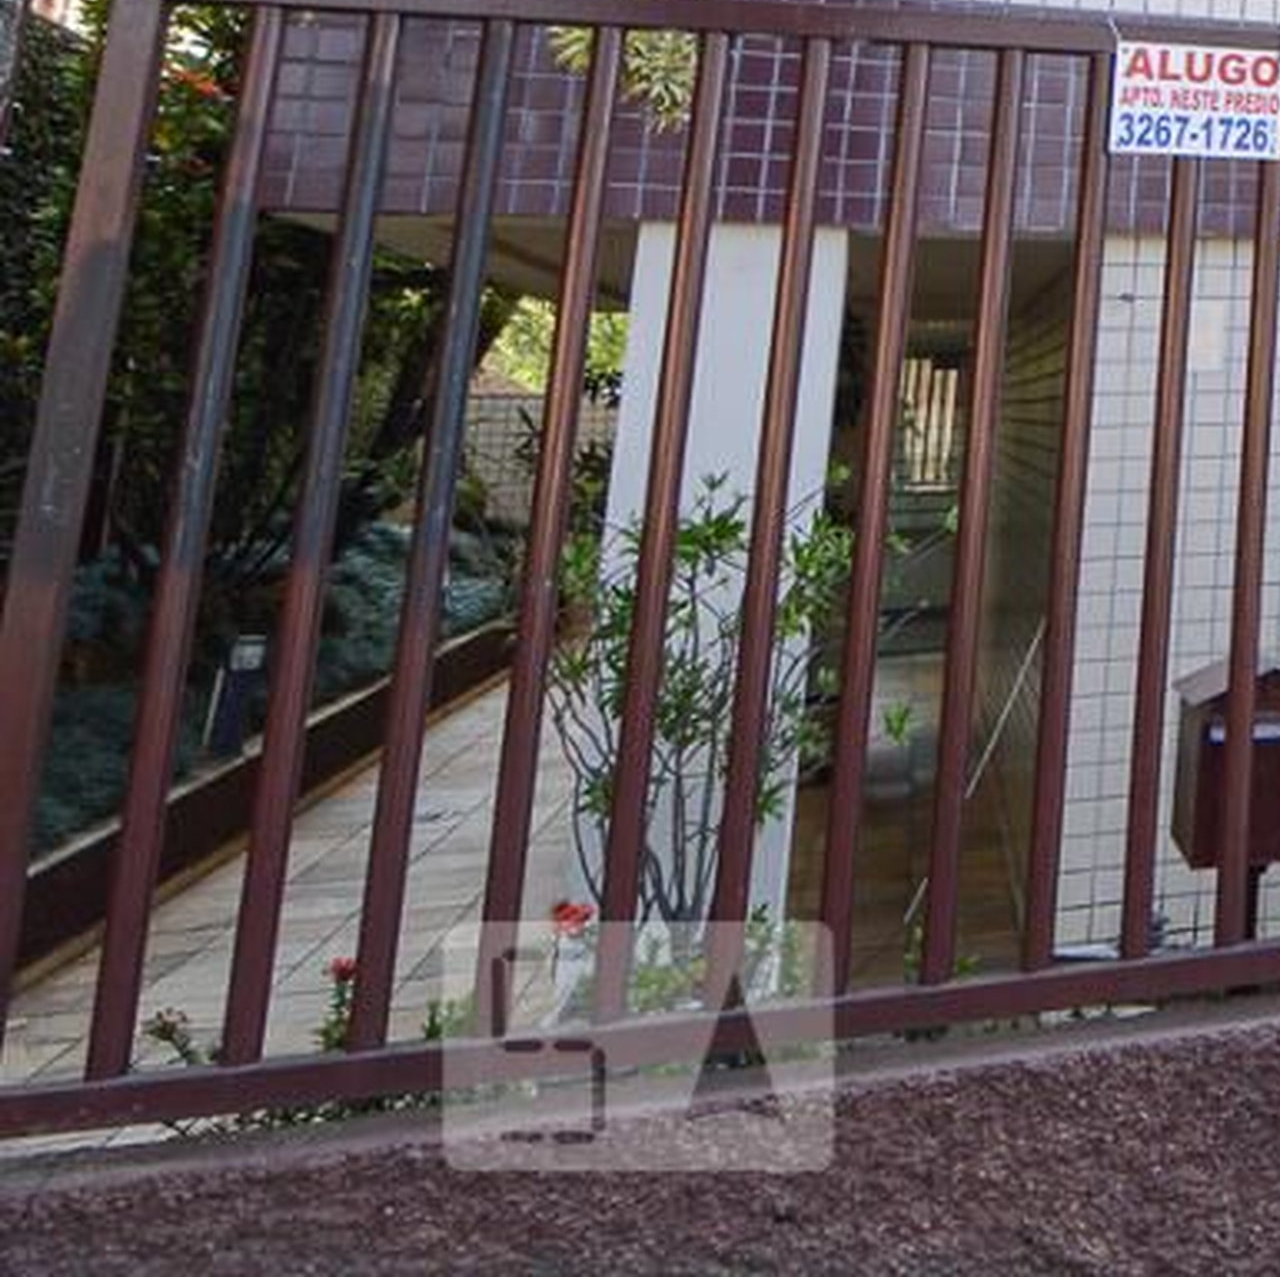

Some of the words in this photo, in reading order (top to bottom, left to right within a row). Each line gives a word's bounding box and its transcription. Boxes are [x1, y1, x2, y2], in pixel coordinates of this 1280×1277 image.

[1125, 48, 1280, 87] ALUGO
[1170, 88, 1219, 111] NESTE
[1117, 112, 1268, 152] 3267-1726
